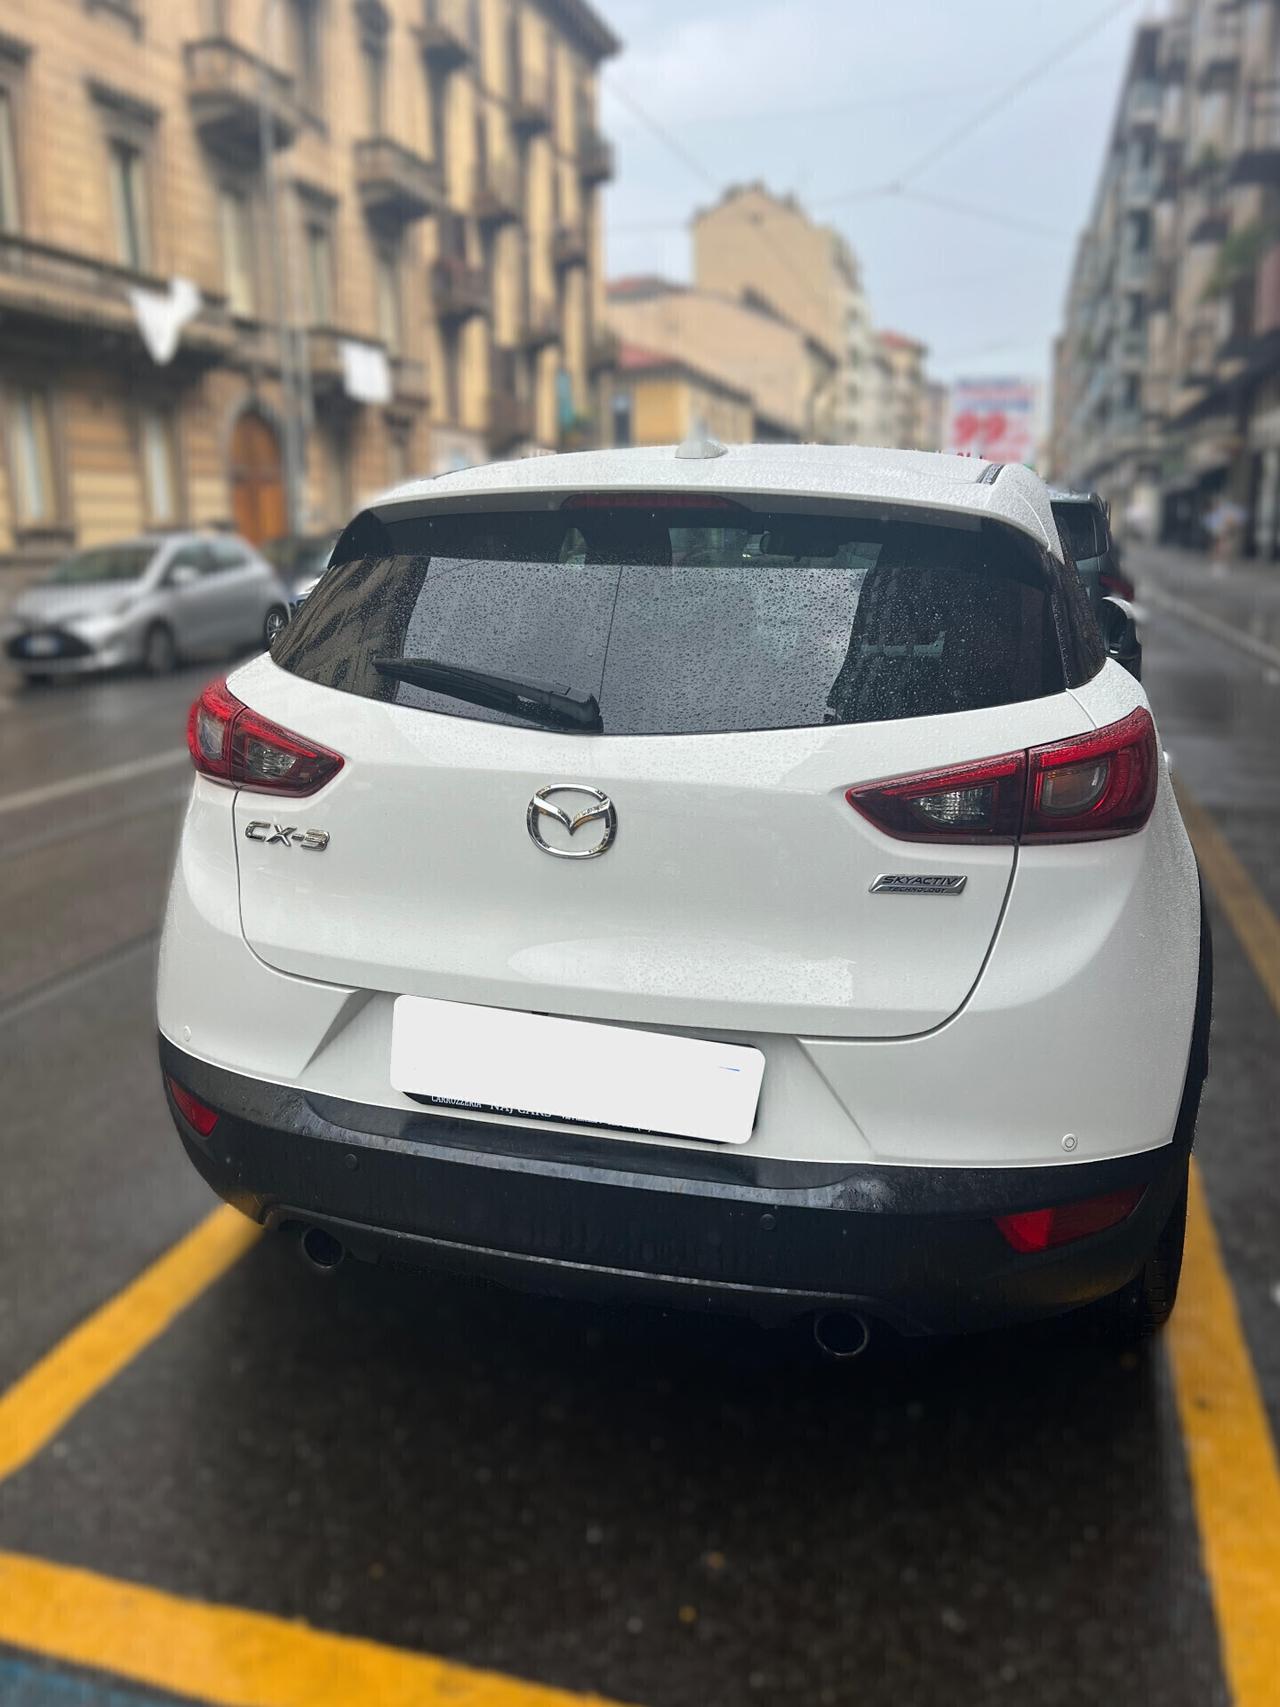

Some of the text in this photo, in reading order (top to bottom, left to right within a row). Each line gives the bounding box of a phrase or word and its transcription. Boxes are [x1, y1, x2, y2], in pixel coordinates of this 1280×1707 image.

[245, 821, 330, 851] CX-3
[882, 875, 958, 886] SKYACTIV
[887, 886, 946, 894] TECHNOLOGY
